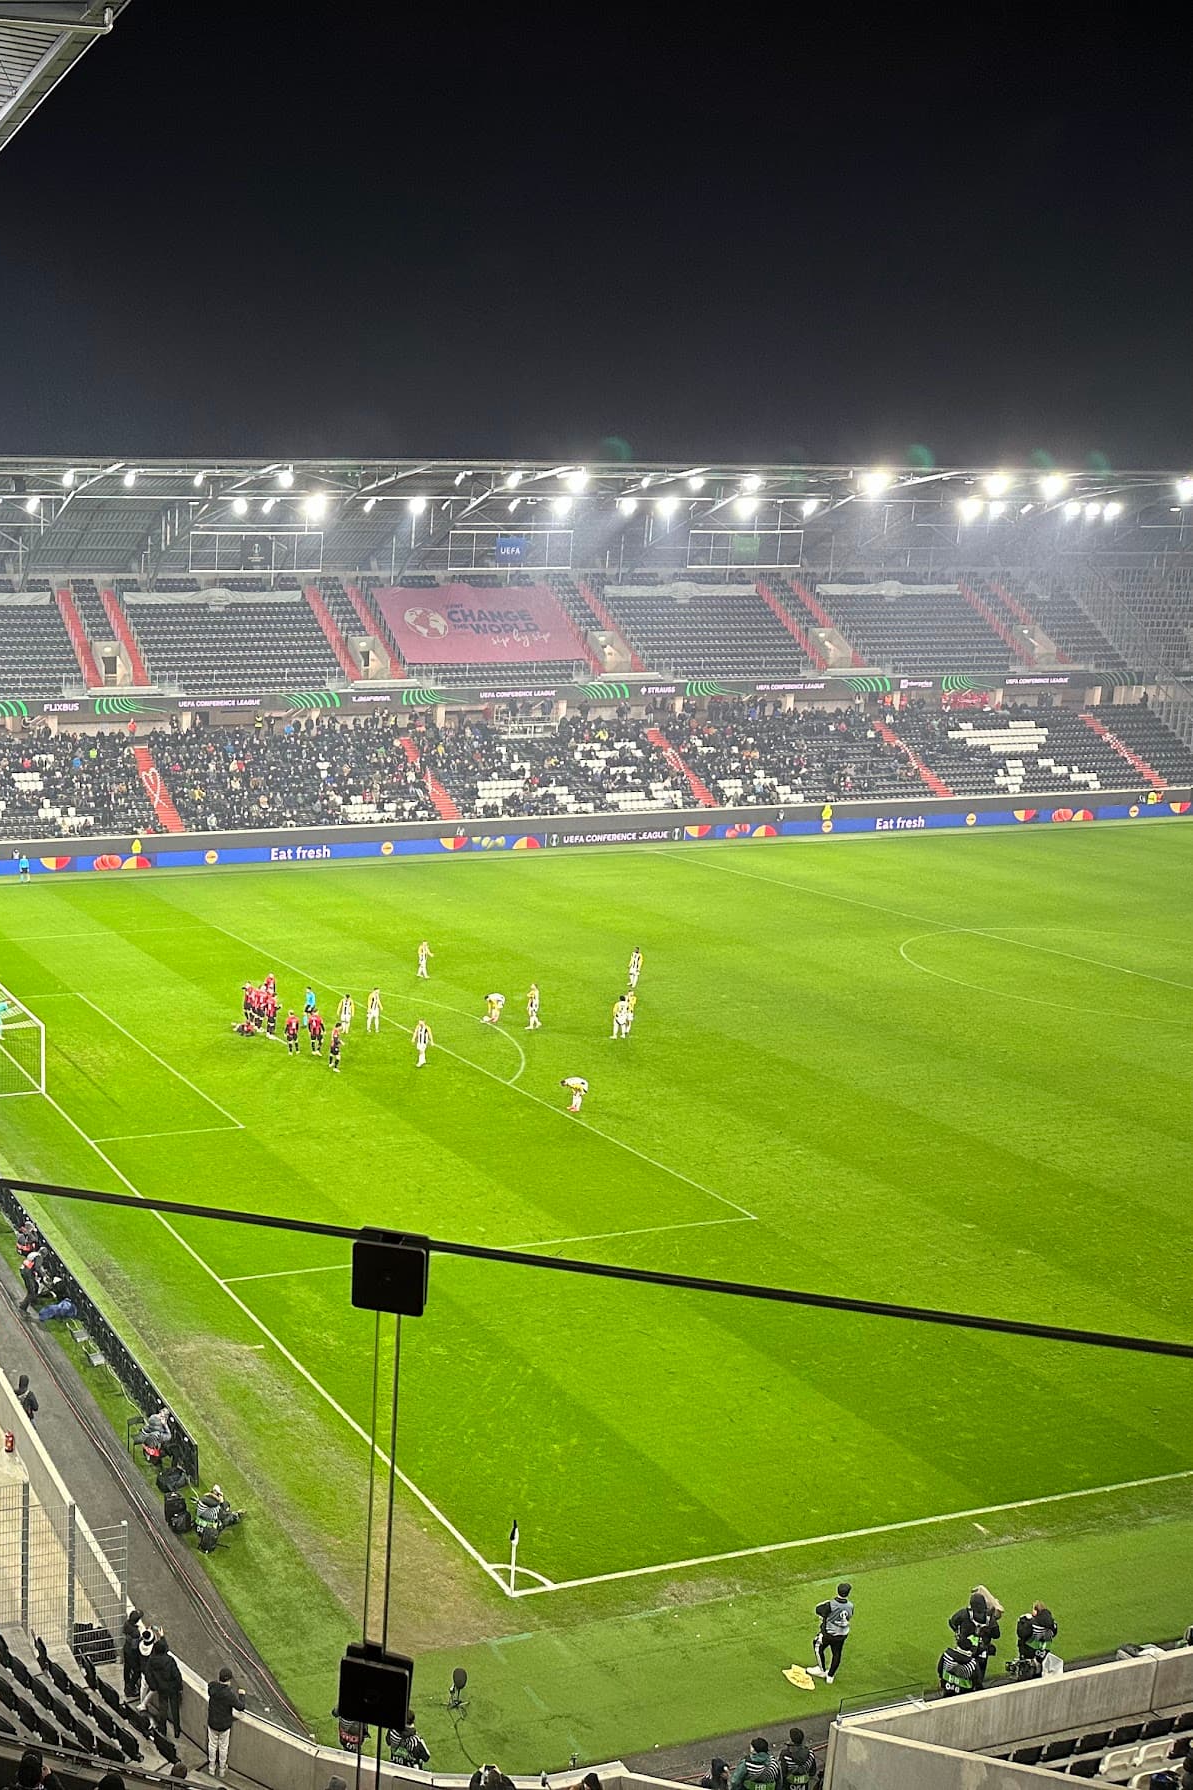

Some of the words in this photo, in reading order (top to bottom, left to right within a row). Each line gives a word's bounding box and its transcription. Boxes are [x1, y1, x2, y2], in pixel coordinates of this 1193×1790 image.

[447, 609, 533, 623] CHANGE
[470, 623, 539, 634] WORLD
[513, 628, 530, 647] by
[43, 703, 80, 712] FLIXBUS
[875, 818, 894, 830] Eat
[896, 816, 925, 829] fresh
[585, 833, 637, 842] CONFERENCE
[270, 847, 293, 861] Eat
[296, 844, 331, 860] fresh
